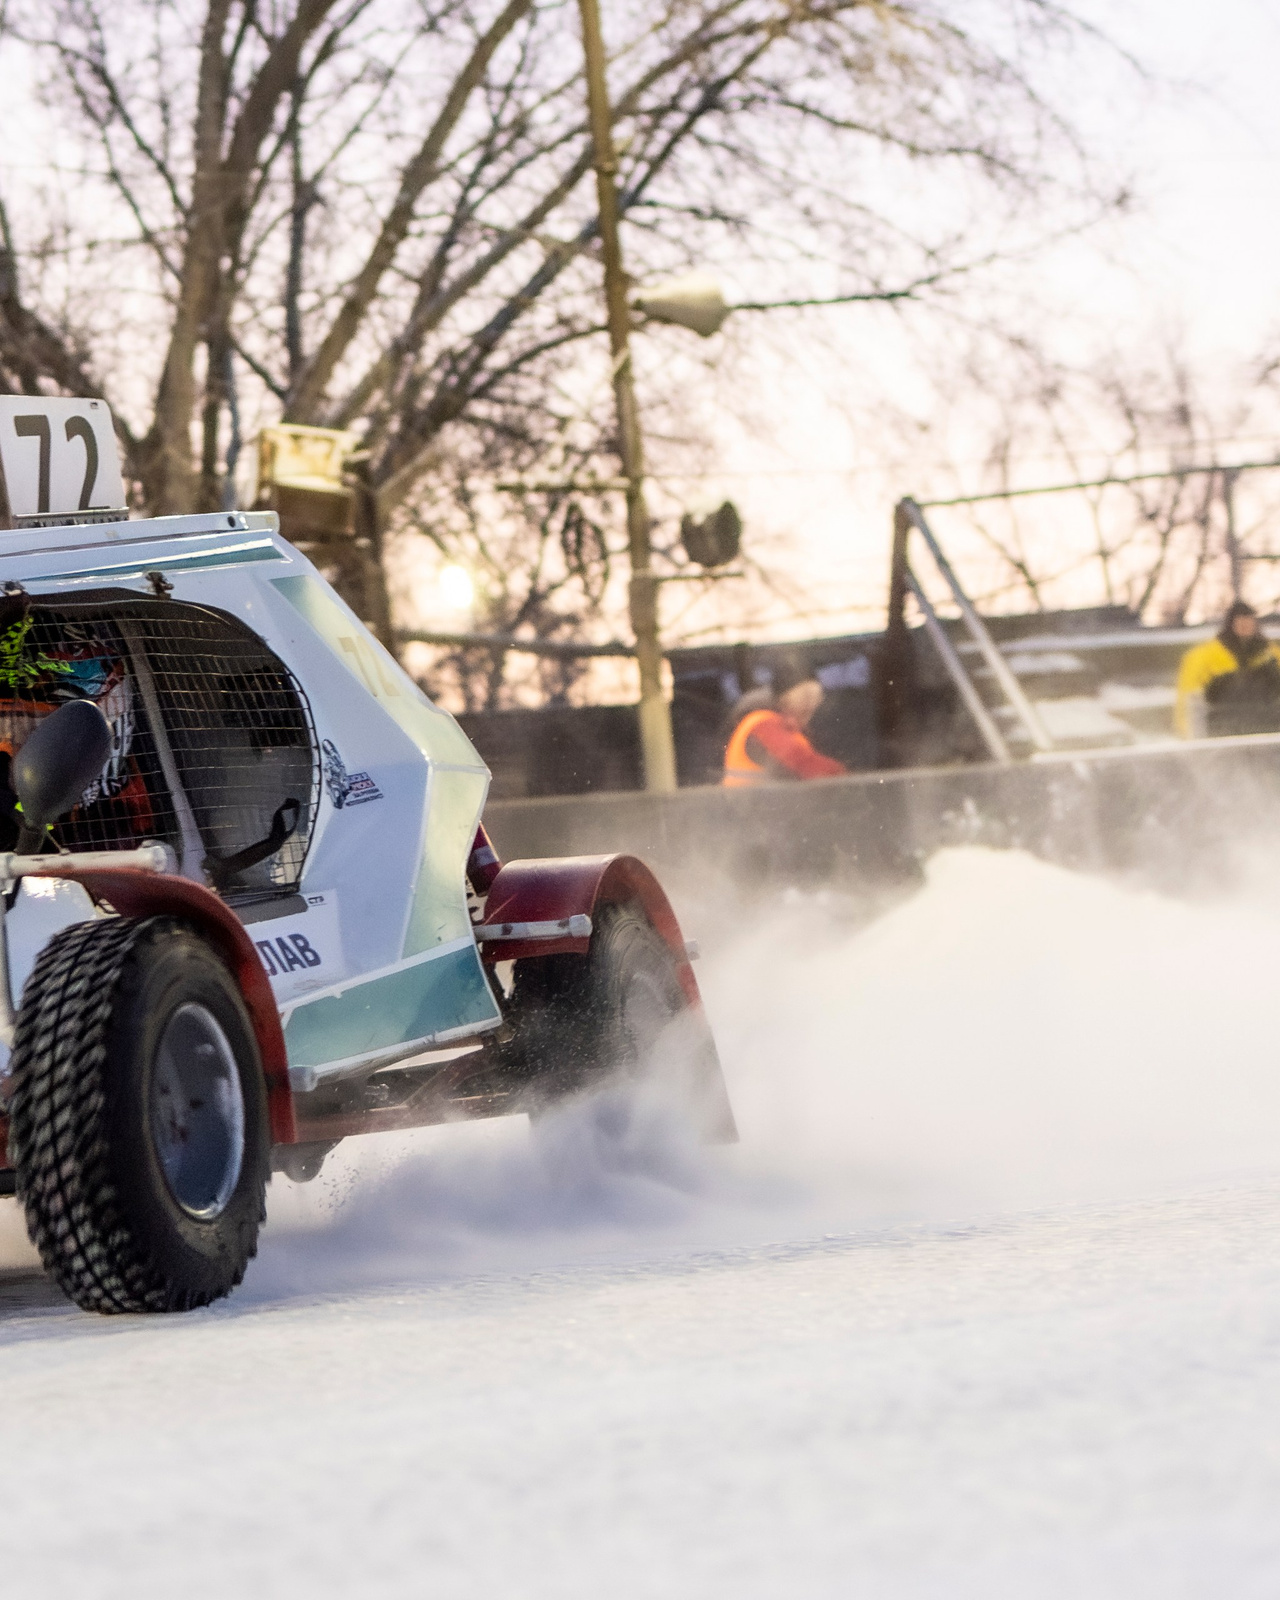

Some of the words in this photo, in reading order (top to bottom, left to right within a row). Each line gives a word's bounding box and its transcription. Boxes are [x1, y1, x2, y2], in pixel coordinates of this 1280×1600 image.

[13, 414, 111, 514] 72
[336, 635, 401, 698] 72
[255, 933, 322, 977] ЛАВ
